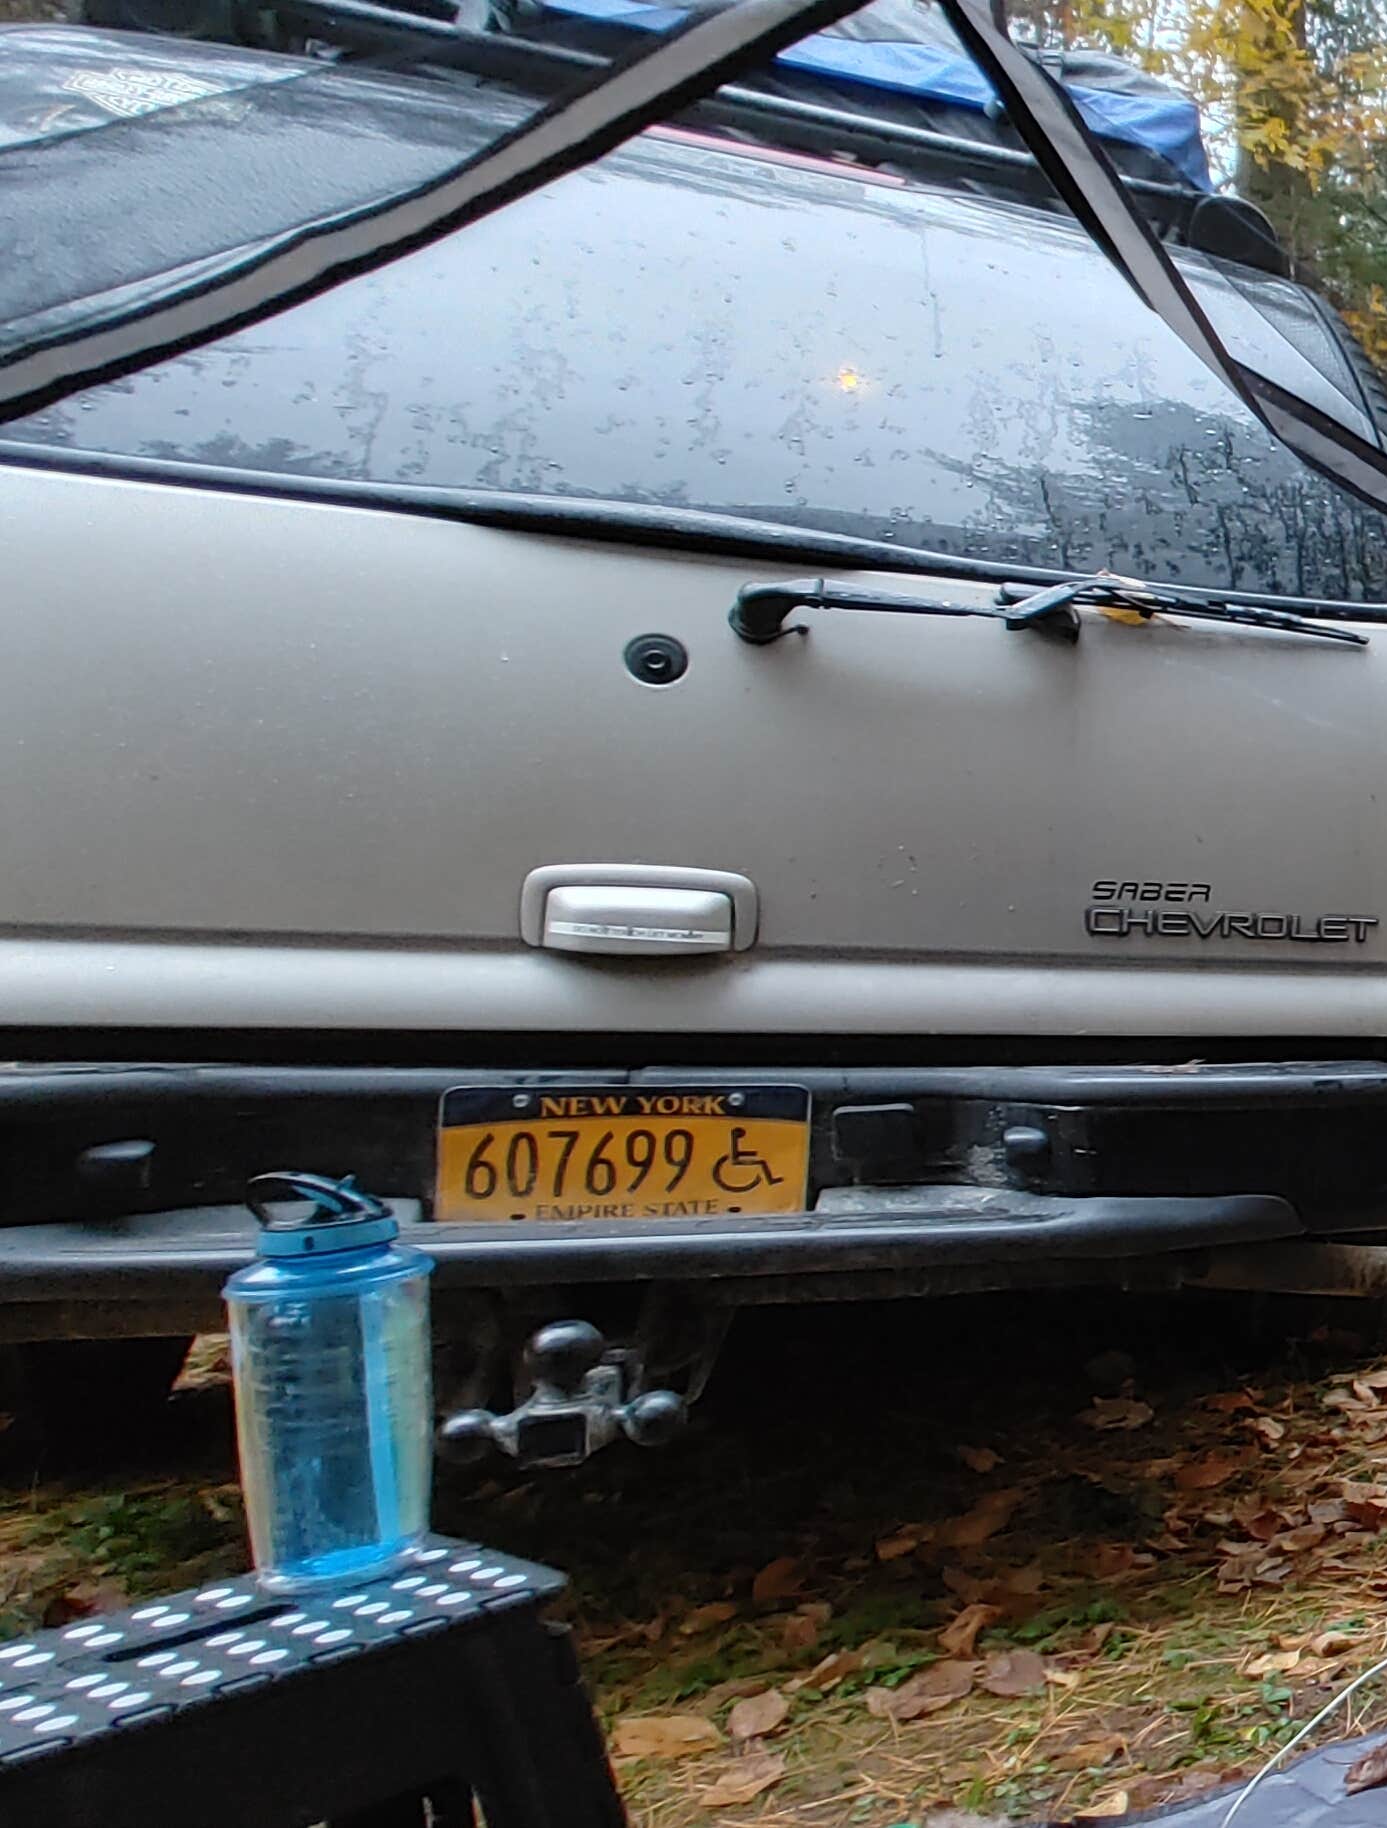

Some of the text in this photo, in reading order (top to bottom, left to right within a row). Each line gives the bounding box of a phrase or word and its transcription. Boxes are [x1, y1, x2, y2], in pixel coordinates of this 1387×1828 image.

[1091, 880, 1212, 902] SABER
[1085, 905, 1380, 944] CHEVROLET
[540, 1093, 727, 1118] NEW YORK
[464, 1128, 695, 1200] 607699
[534, 1199, 721, 1220] EMPIRE STATE
